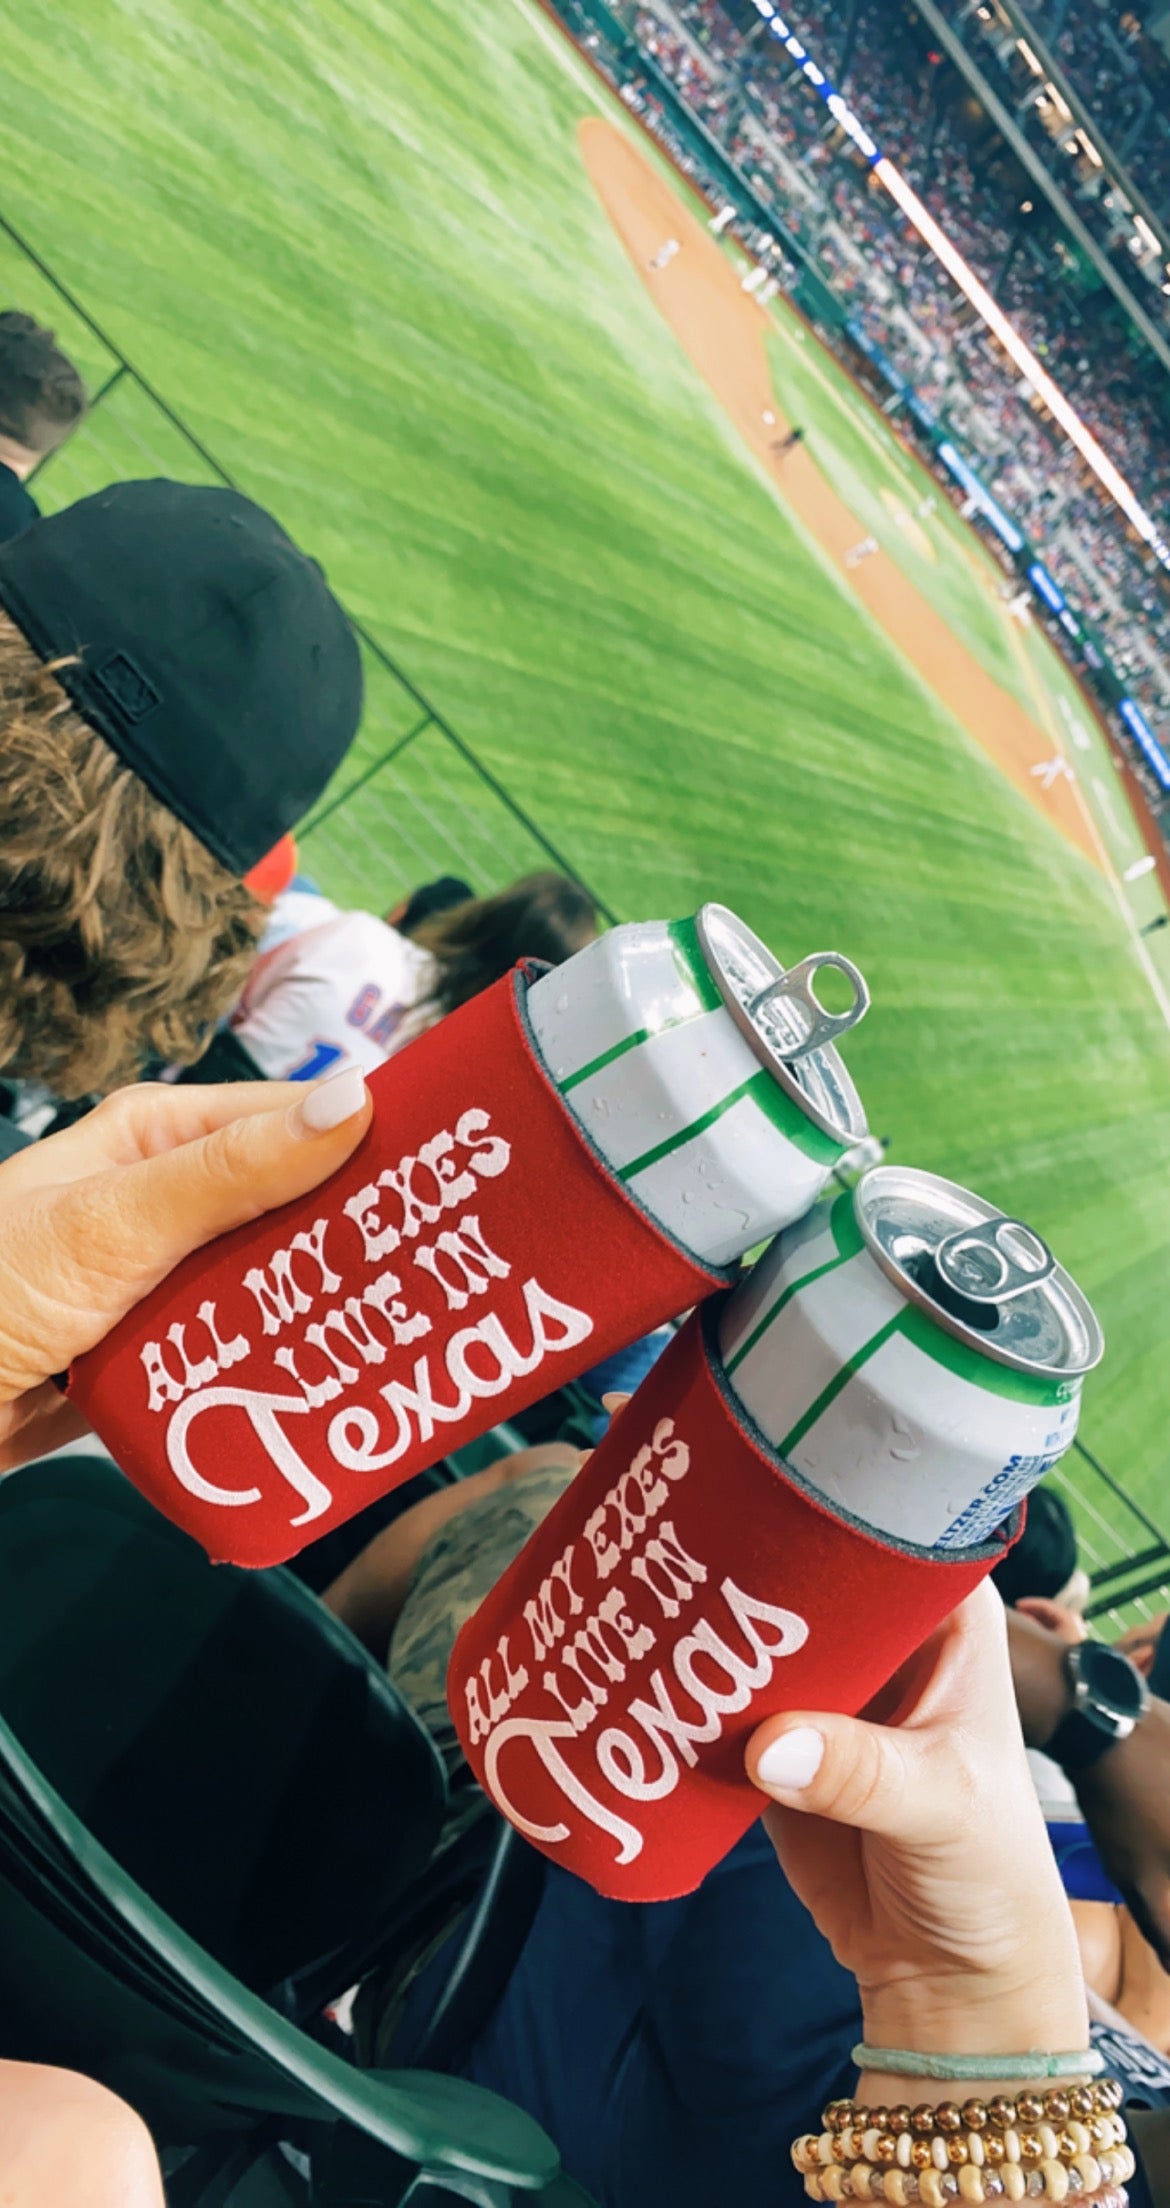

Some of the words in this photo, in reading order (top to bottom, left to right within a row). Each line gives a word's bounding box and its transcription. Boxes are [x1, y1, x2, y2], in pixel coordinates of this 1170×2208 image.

[139, 1300, 251, 1412] ALL
[242, 1218, 343, 1336] MY
[343, 1107, 512, 1263] EXES
[273, 1271, 433, 1409] LIVE
[412, 1214, 512, 1311] IN
[166, 1276, 594, 1528] Texas
[464, 1634, 530, 1745] ALL
[522, 1544, 584, 1662] MY
[582, 1416, 690, 1579] EXES
[543, 1586, 657, 1732] LIVE
[630, 1520, 708, 1619] IN
[484, 1576, 810, 1866] Texas
